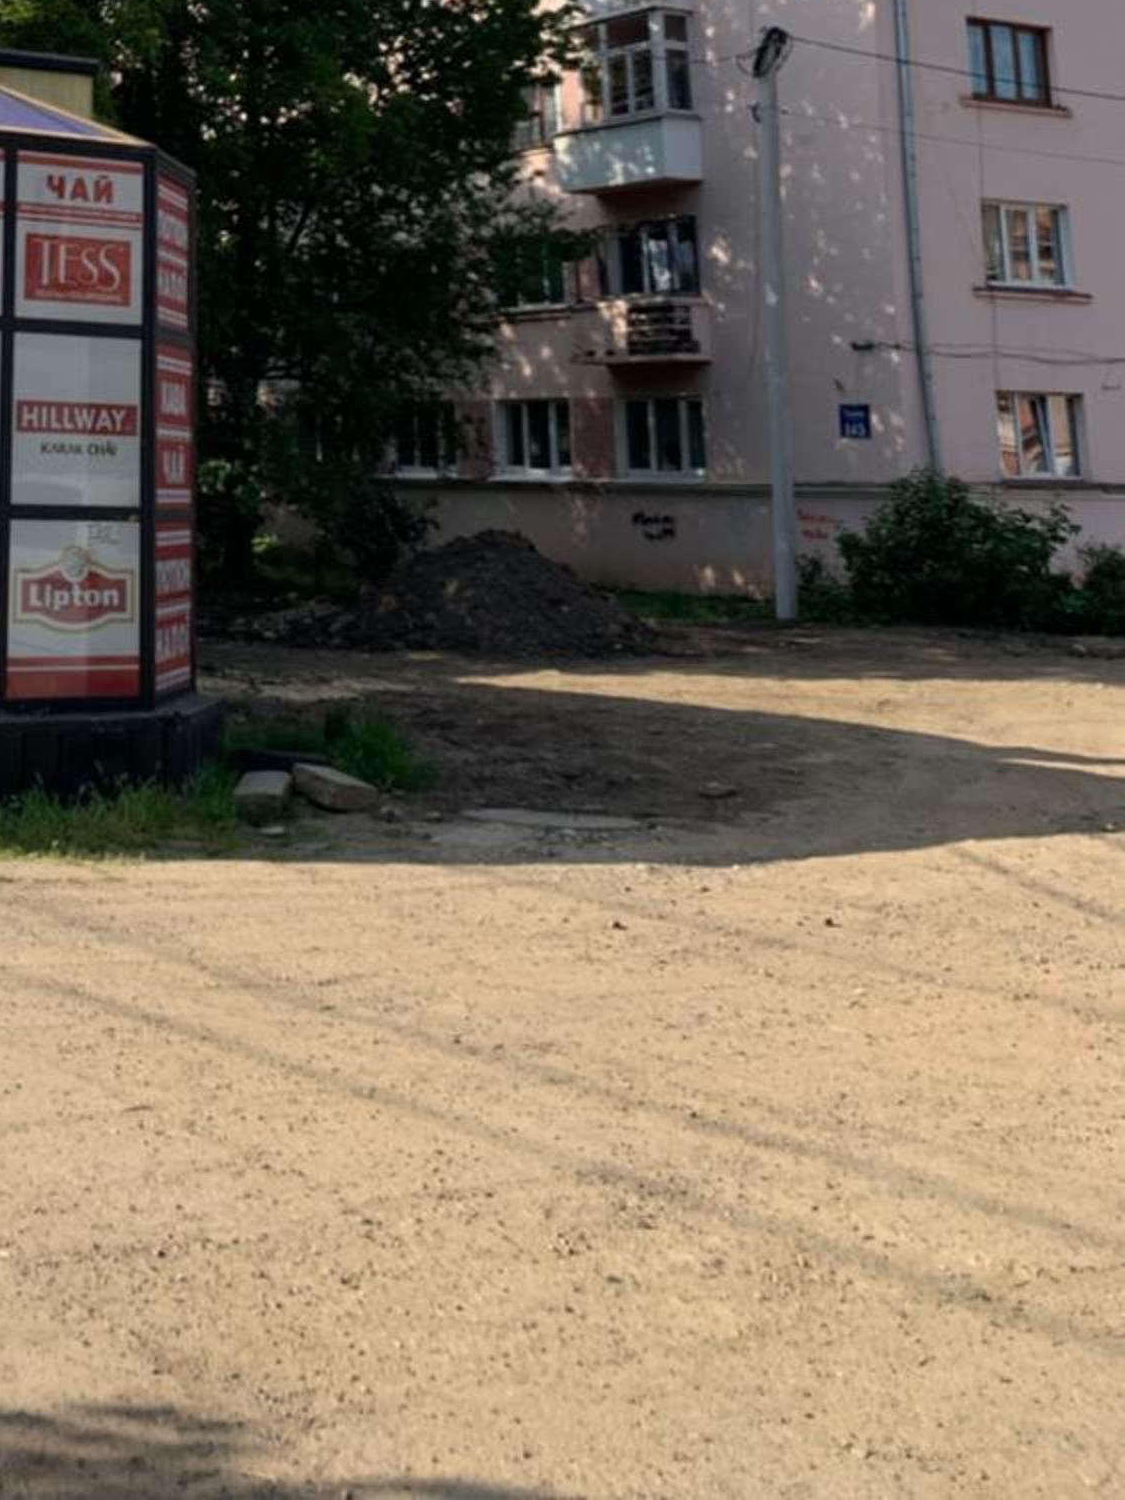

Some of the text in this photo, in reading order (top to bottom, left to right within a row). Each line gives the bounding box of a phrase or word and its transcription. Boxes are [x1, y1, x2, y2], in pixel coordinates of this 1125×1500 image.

[47, 174, 115, 204] ЧАЙ
[21, 404, 126, 432] HILLWAY
[28, 583, 119, 612] Lipton
